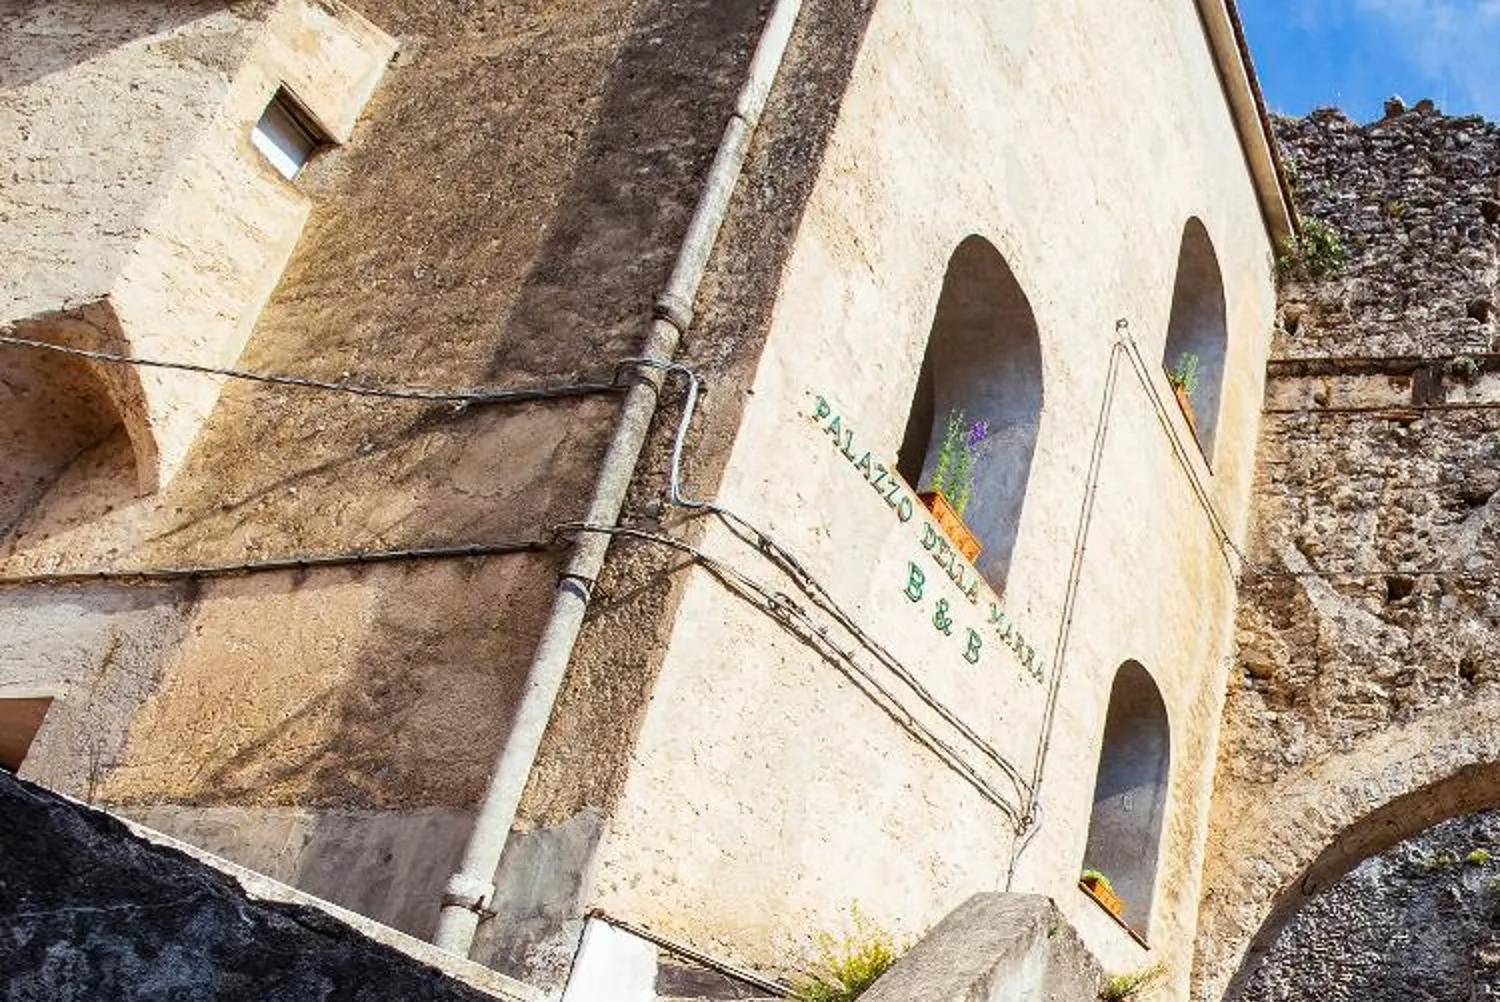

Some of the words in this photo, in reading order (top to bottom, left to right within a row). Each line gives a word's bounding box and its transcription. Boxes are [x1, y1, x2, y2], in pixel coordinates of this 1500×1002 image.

[812, 393, 913, 523] PALAZZO
[920, 521, 978, 605] DELLA
[903, 560, 926, 603] B
[932, 597, 953, 636] &
[962, 627, 983, 664] B
